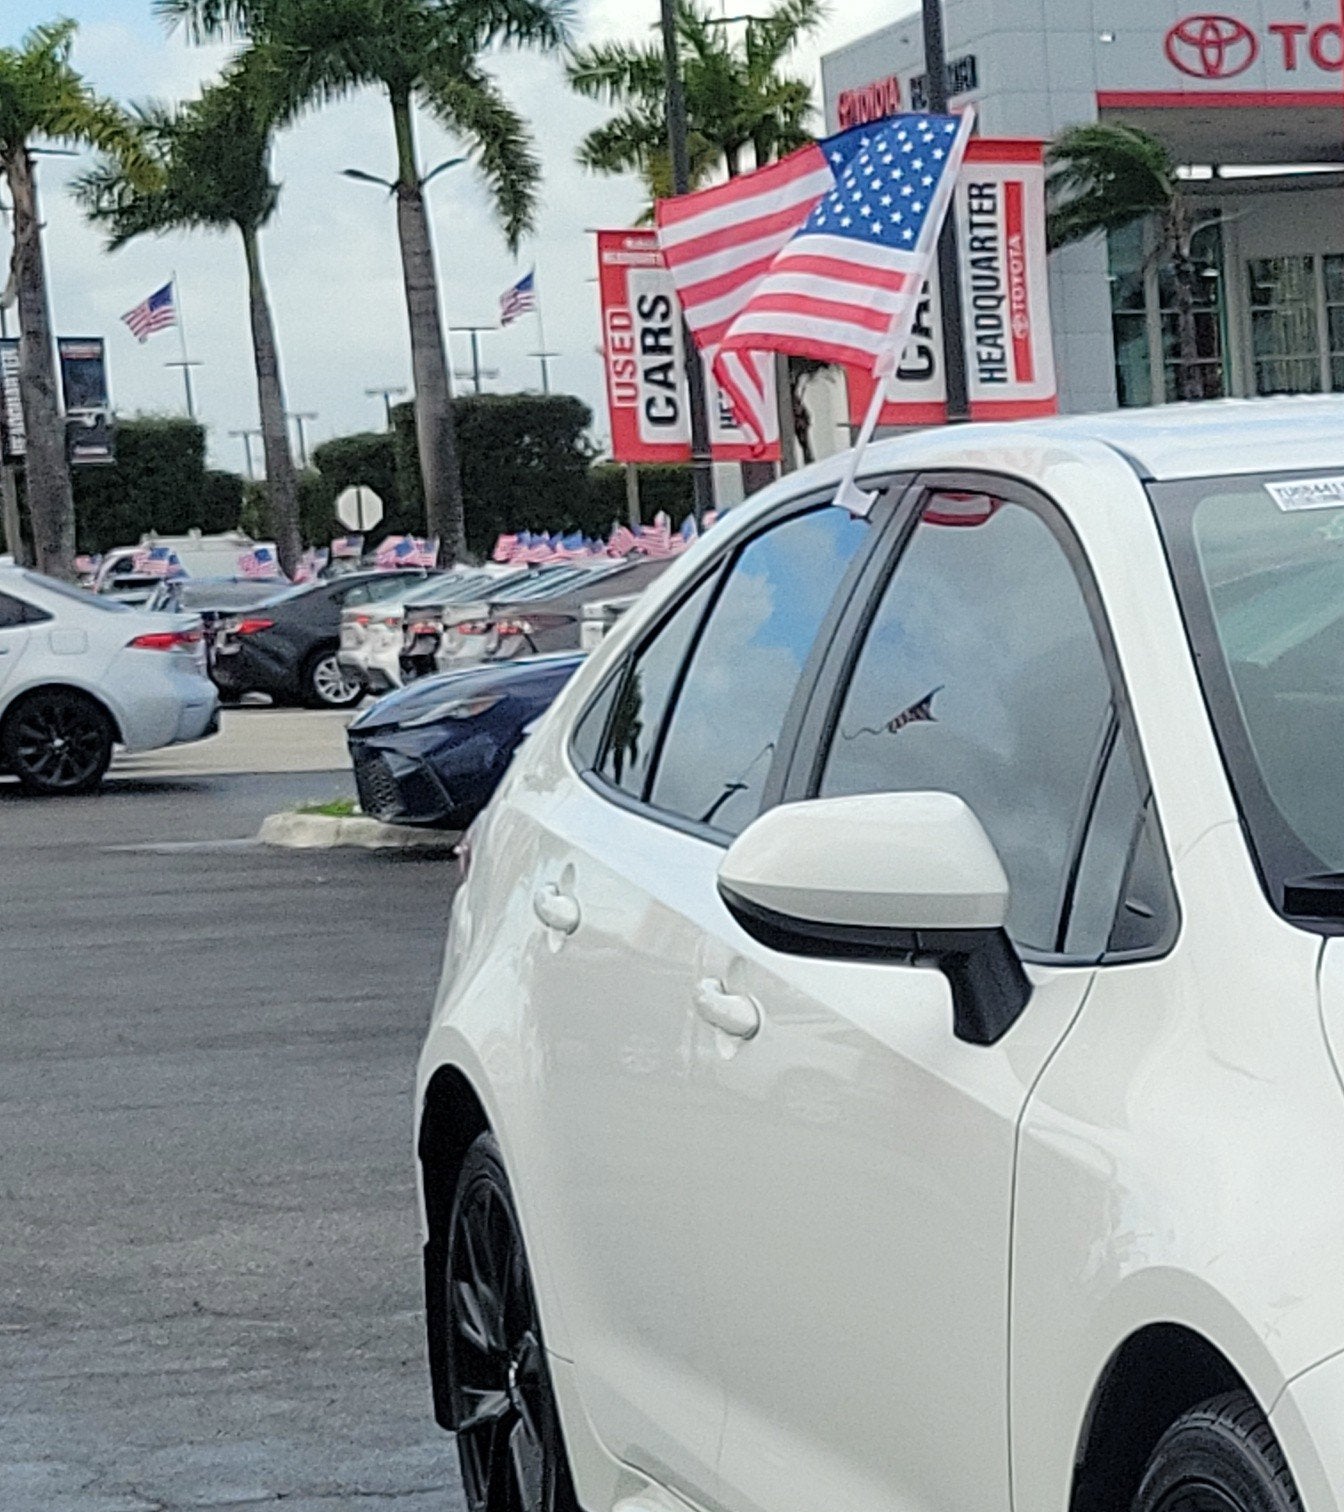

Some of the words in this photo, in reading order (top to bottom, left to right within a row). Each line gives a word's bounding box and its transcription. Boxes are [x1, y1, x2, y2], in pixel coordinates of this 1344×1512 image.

[968, 182, 1008, 384] HEADQUARTER
[608, 309, 639, 406] USED
[637, 294, 679, 426] CARS
